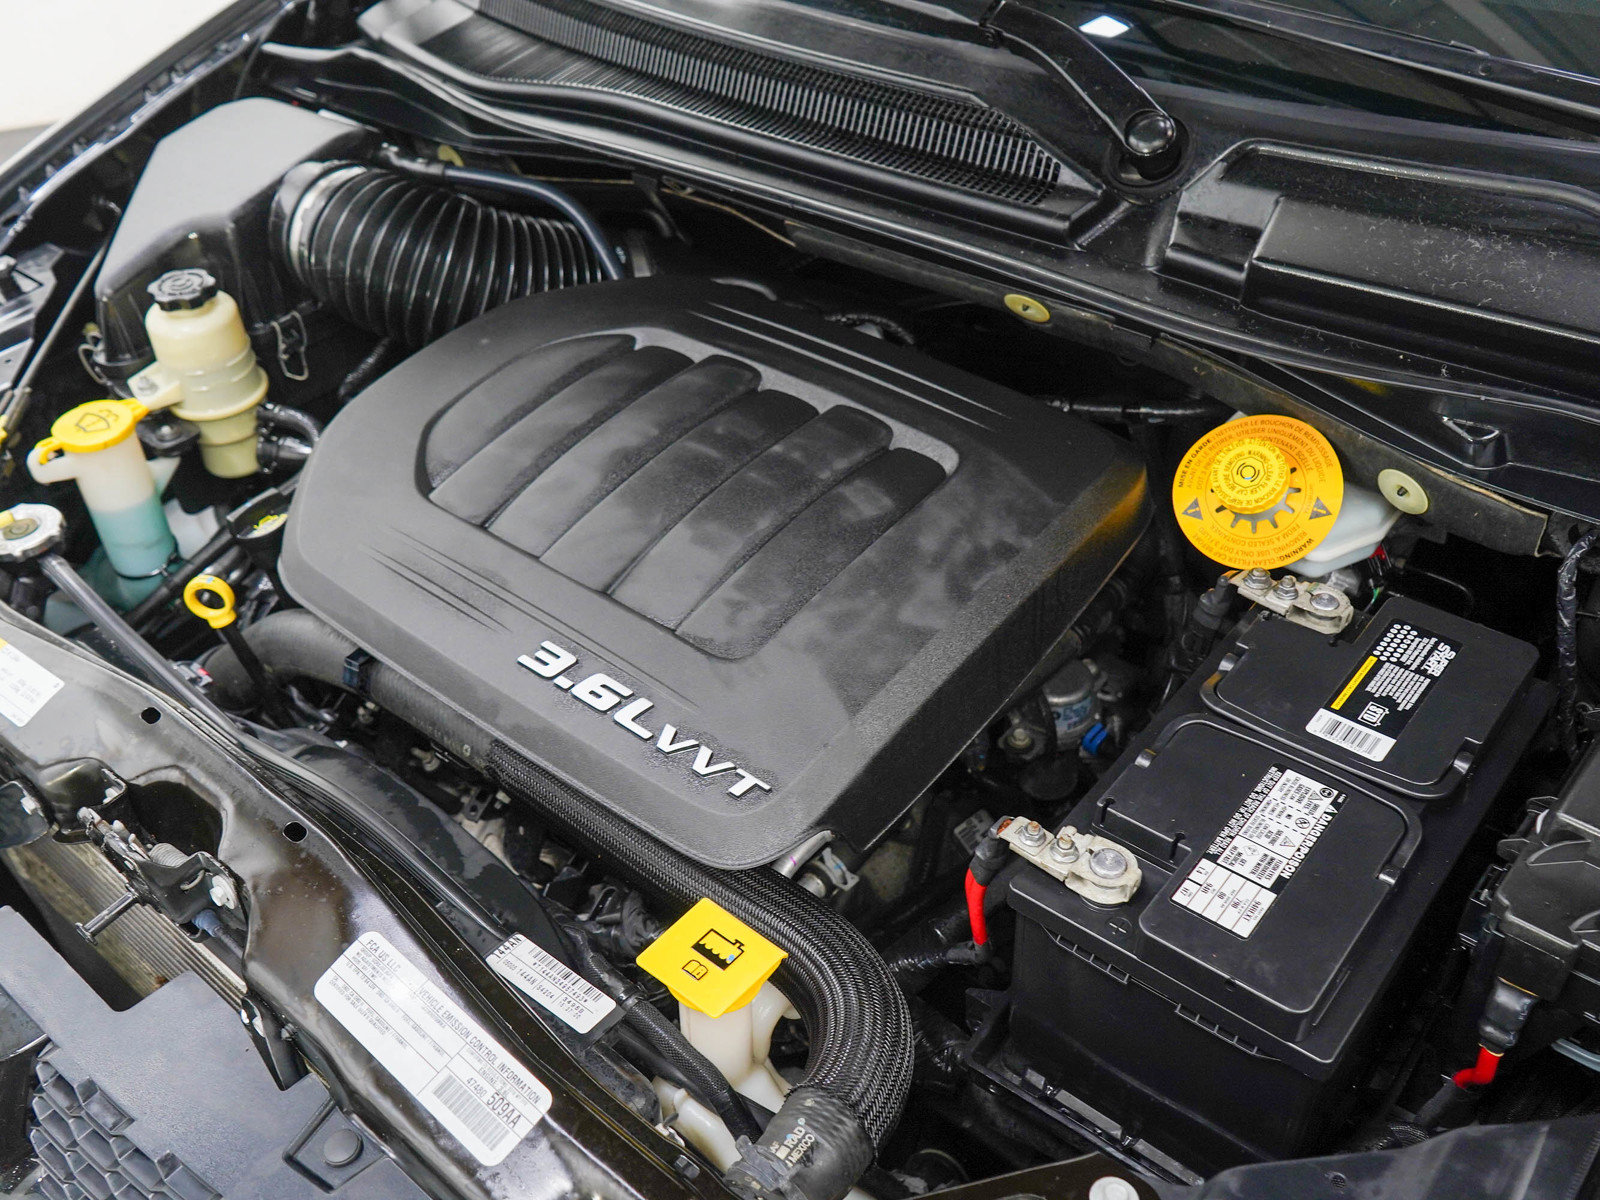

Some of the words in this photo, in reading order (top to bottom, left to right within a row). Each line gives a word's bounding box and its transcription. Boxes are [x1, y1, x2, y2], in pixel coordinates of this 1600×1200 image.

[1267, 428, 1308, 448] UNIQUEMENT
[1178, 470, 1187, 487] MISE
[1185, 459, 1193, 468] EN
[1216, 422, 1248, 437] NETTOYER
[1260, 420, 1293, 429] BOUCHON
[1294, 425, 1302, 434] DE
[1303, 431, 1333, 467] REMPLISSAGE
[1248, 539, 1273, 547] SEALED
[1281, 524, 1300, 541] FROM
[1235, 549, 1255, 557] ONLY
[1254, 558, 1276, 566] CLEAN
[1256, 549, 1271, 557] USE
[1420, 641, 1451, 675] START
[1429, 648, 1456, 677] SUPER
[515, 639, 655, 741] 3.6L
[655, 722, 773, 800] VVT
[1278, 812, 1333, 879] DANGER/POISON
[365, 938, 380, 954] FCA
[377, 949, 390, 962] US
[385, 957, 401, 972] LLC
[418, 986, 444, 1013] VEHICLE
[440, 1009, 472, 1039] EMISSION
[468, 1035, 498, 1066] CONTROL
[496, 1061, 541, 1104] INFORMATION
[485, 1090, 521, 1128] 509AA
[789, 1134, 816, 1163] MEXICO
